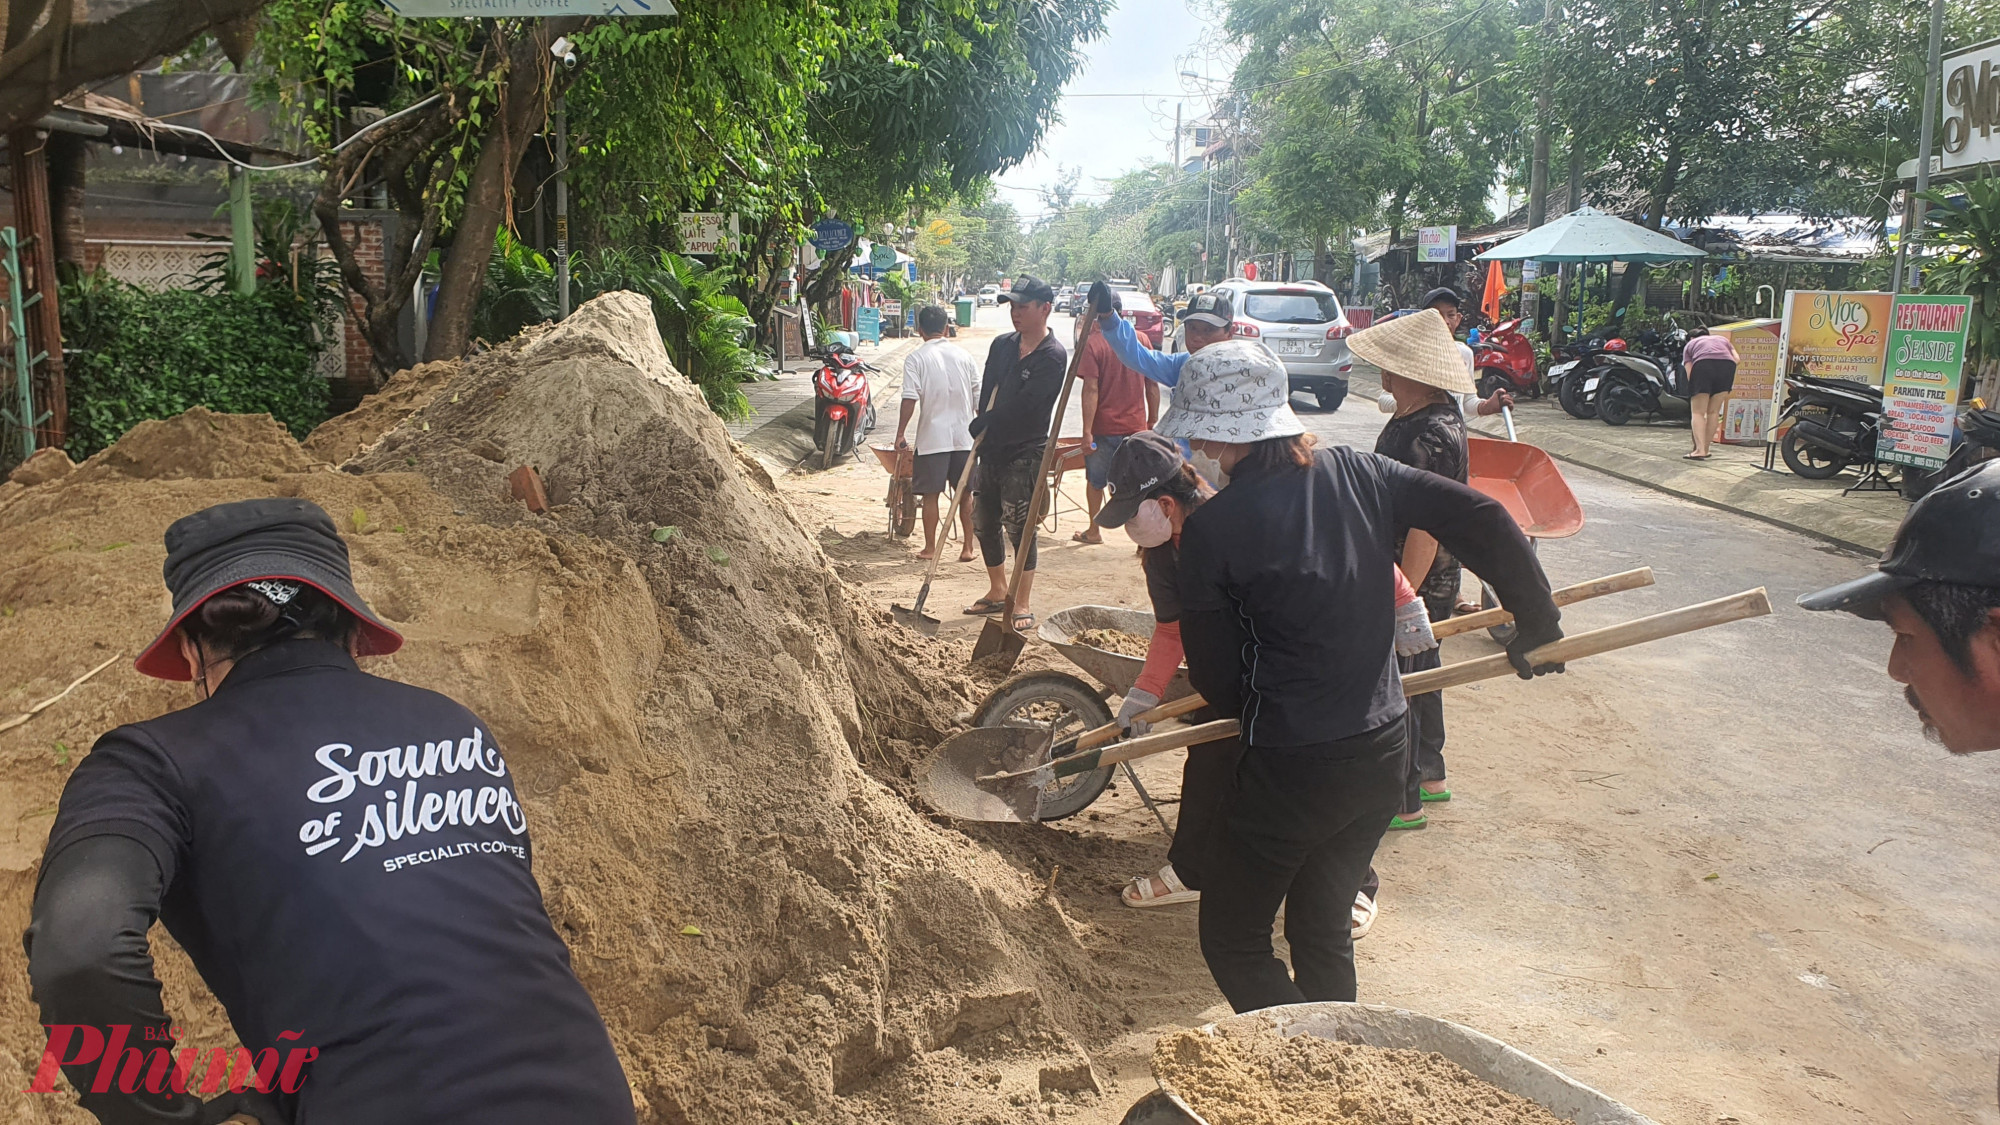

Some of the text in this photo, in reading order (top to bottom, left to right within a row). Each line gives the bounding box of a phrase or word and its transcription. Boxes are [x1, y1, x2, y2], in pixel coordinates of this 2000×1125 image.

[1895, 303, 1966, 334] RESTAURANT
[1836, 323, 1878, 352] Spa
[1792, 355, 1878, 364] HOT STONE MASSAGE
[1895, 368, 1904, 377] Go
[1912, 370, 1923, 379] the
[1923, 371, 1942, 381] beach
[1893, 386, 1946, 400] PARKING FREE
[1893, 400, 1943, 412] VIETNAMESE FOOD
[1887, 410, 1905, 418] BREAD
[1908, 412, 1927, 422] LOCAL
[1928, 415, 1945, 424] FOOD
[1893, 421, 1936, 433] FRESH SEAFOOD
[1883, 429, 1909, 440] COCKTAIL
[1913, 434, 1929, 444] COLD
[1930, 436, 1944, 445] BEER
[1895, 442, 1928, 454] FRESH JUICE
[307, 726, 506, 804] Sound
[340, 780, 528, 864] silence
[383, 839, 526, 873] SPECIALITY COFFEE
